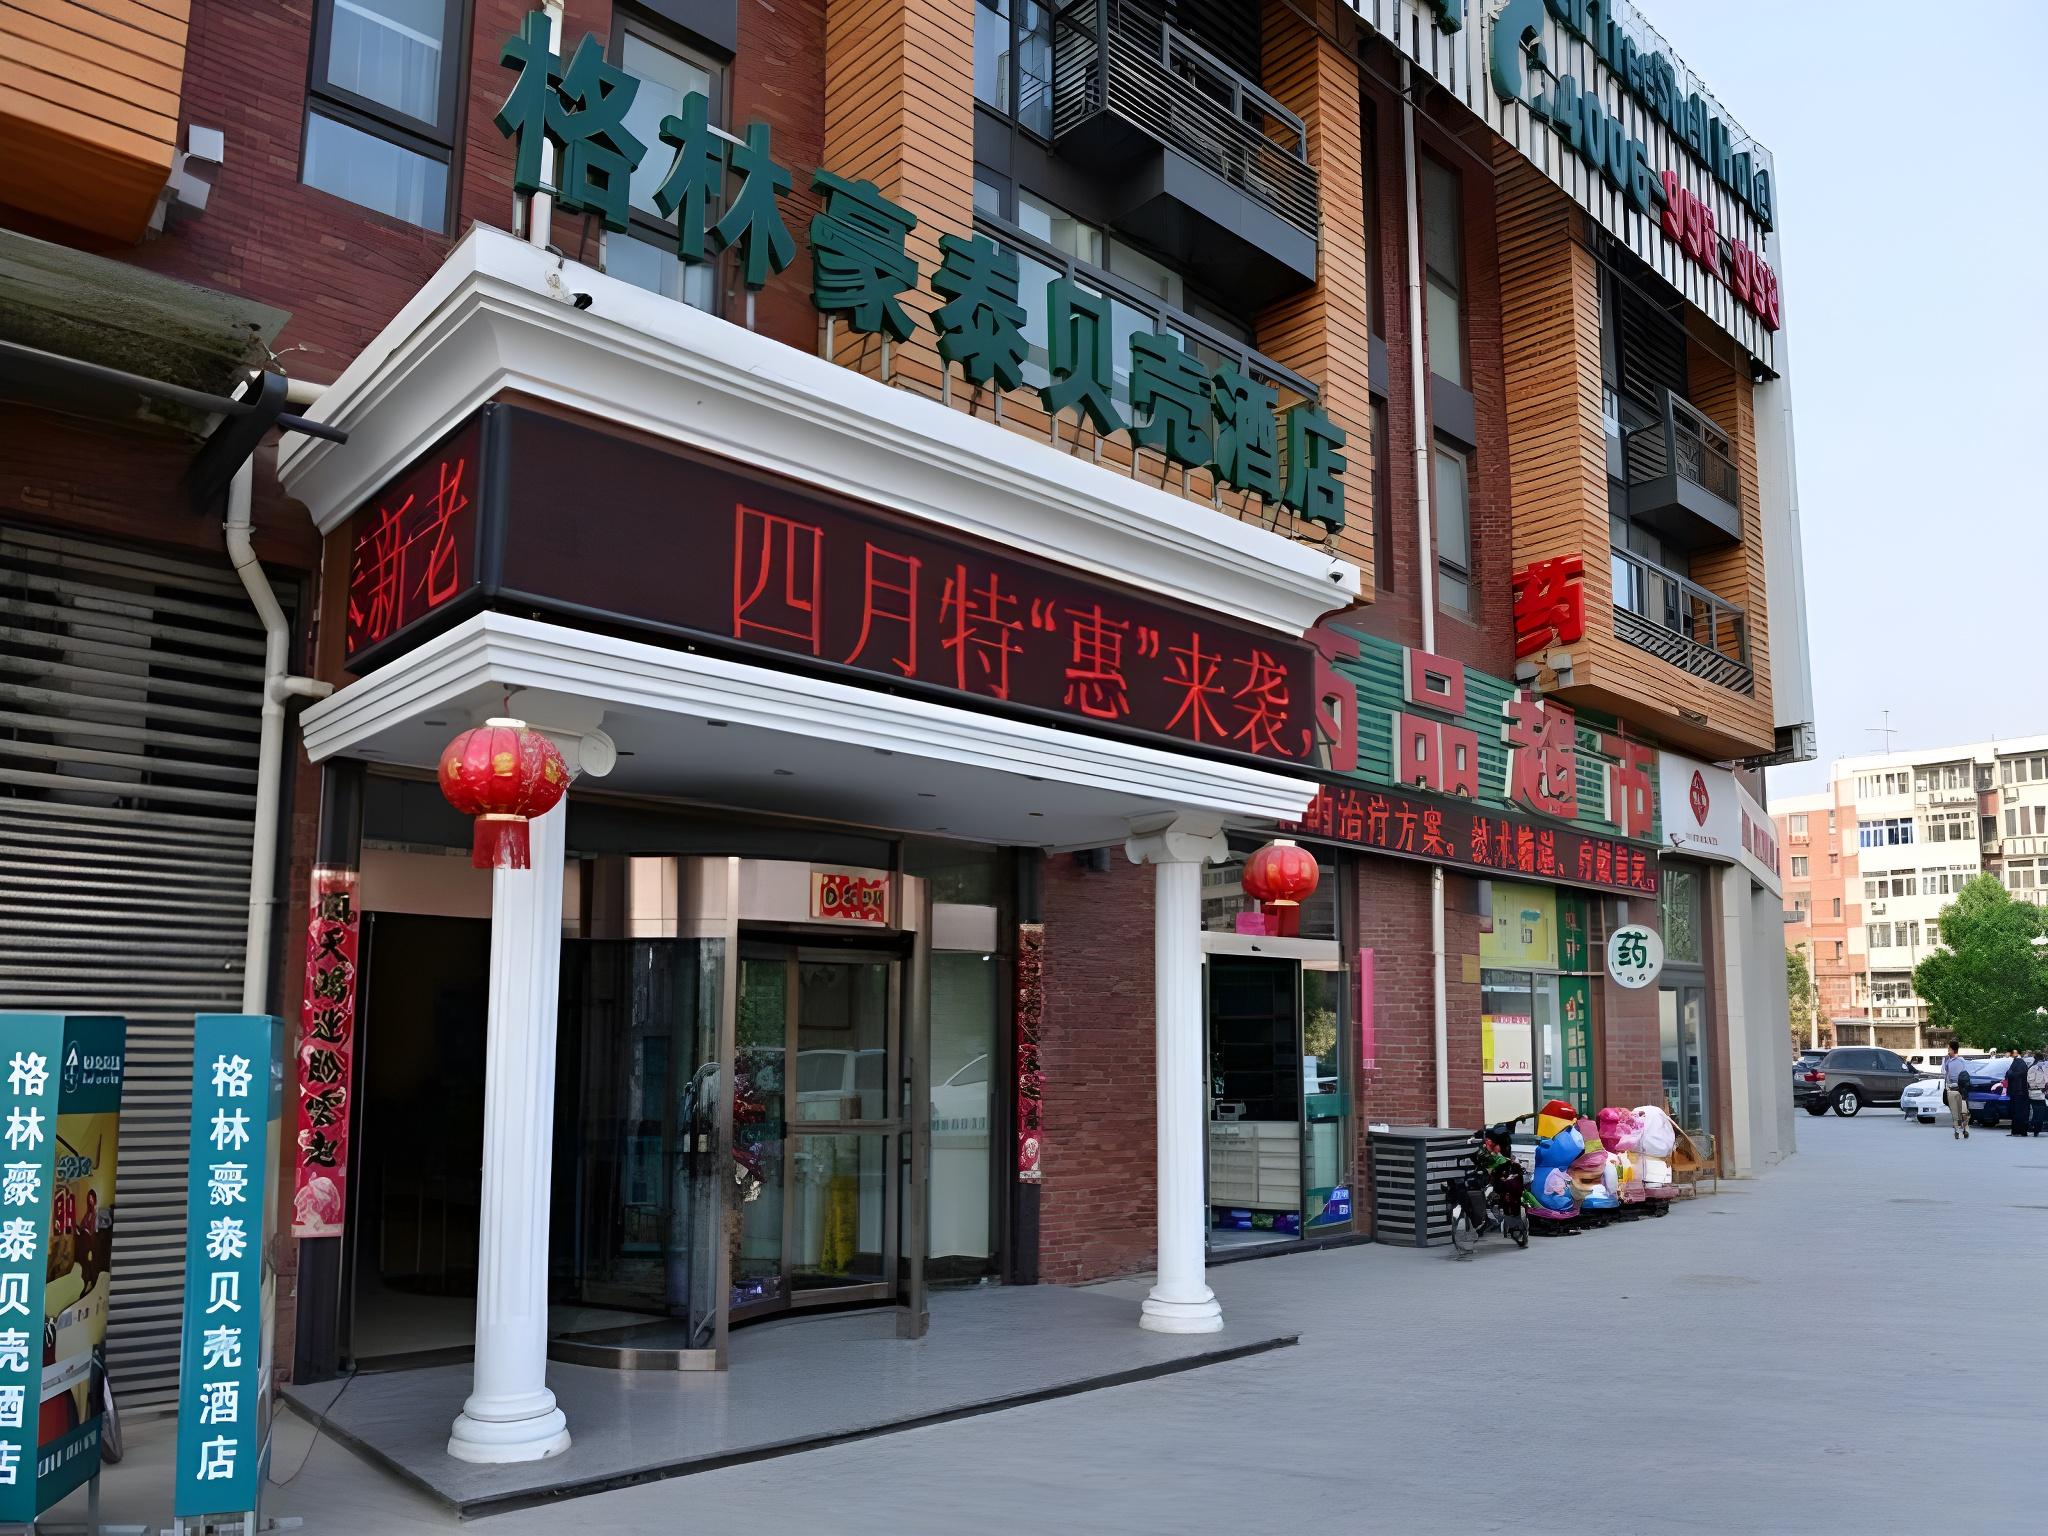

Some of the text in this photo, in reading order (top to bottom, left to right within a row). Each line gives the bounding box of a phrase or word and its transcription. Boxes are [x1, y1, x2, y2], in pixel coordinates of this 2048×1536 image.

[494, 10, 1347, 534] 格林豪泰贝壳酒店
[1617, 931, 1649, 969] 药
[196, 1054, 254, 1481] 格林豪泰贝壳酒店
